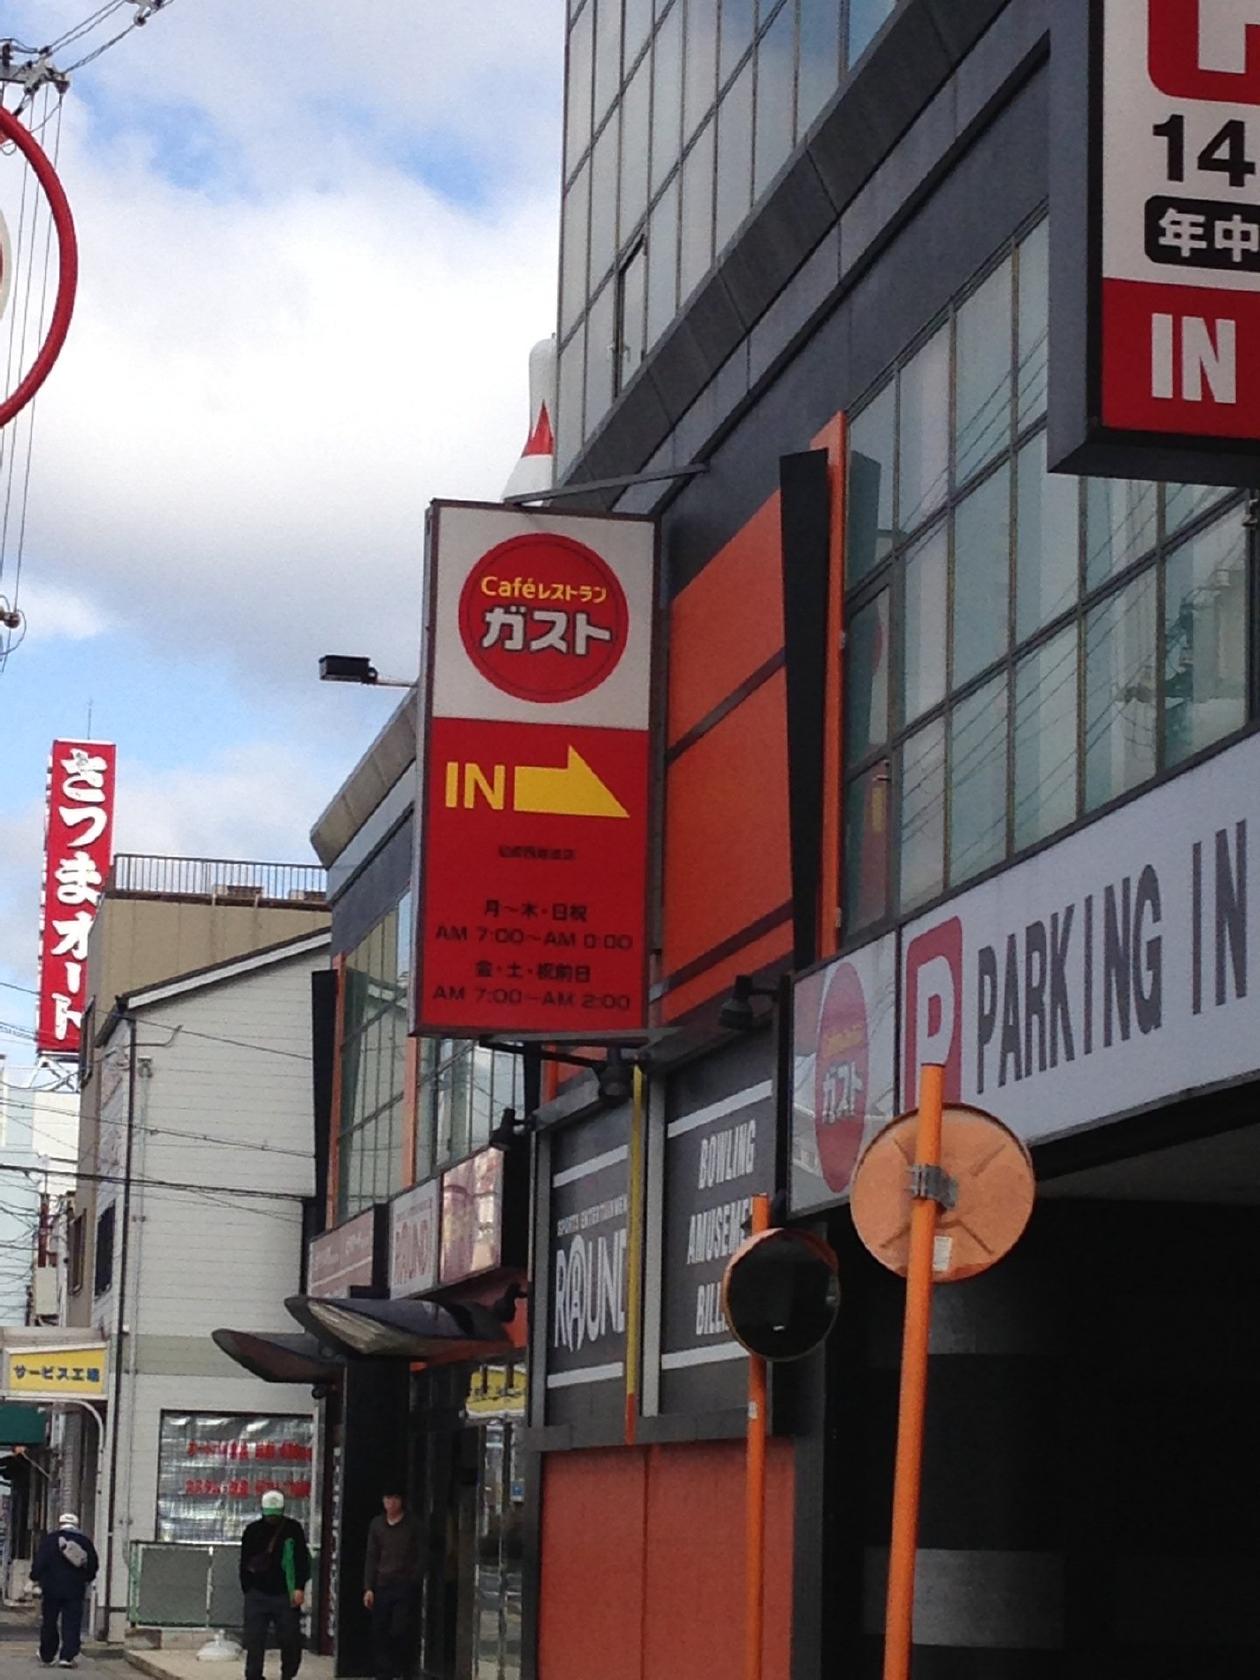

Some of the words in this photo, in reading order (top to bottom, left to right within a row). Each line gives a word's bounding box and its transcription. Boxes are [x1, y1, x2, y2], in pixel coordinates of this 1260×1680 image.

[1152, 113, 1256, 187] 14
[1158, 208, 1259, 263] 年中
[1151, 312, 1237, 404] IN
[481, 605, 612, 656] ガスト
[445, 761, 506, 810] IN
[51, 748, 108, 1041] さつまオート
[976, 863, 1162, 1095] PARKING
[1192, 817, 1248, 1016] IN
[916, 956, 955, 1108] P
[698, 1119, 756, 1190] BOWLING
[687, 1198, 753, 1265] AMUSEME
